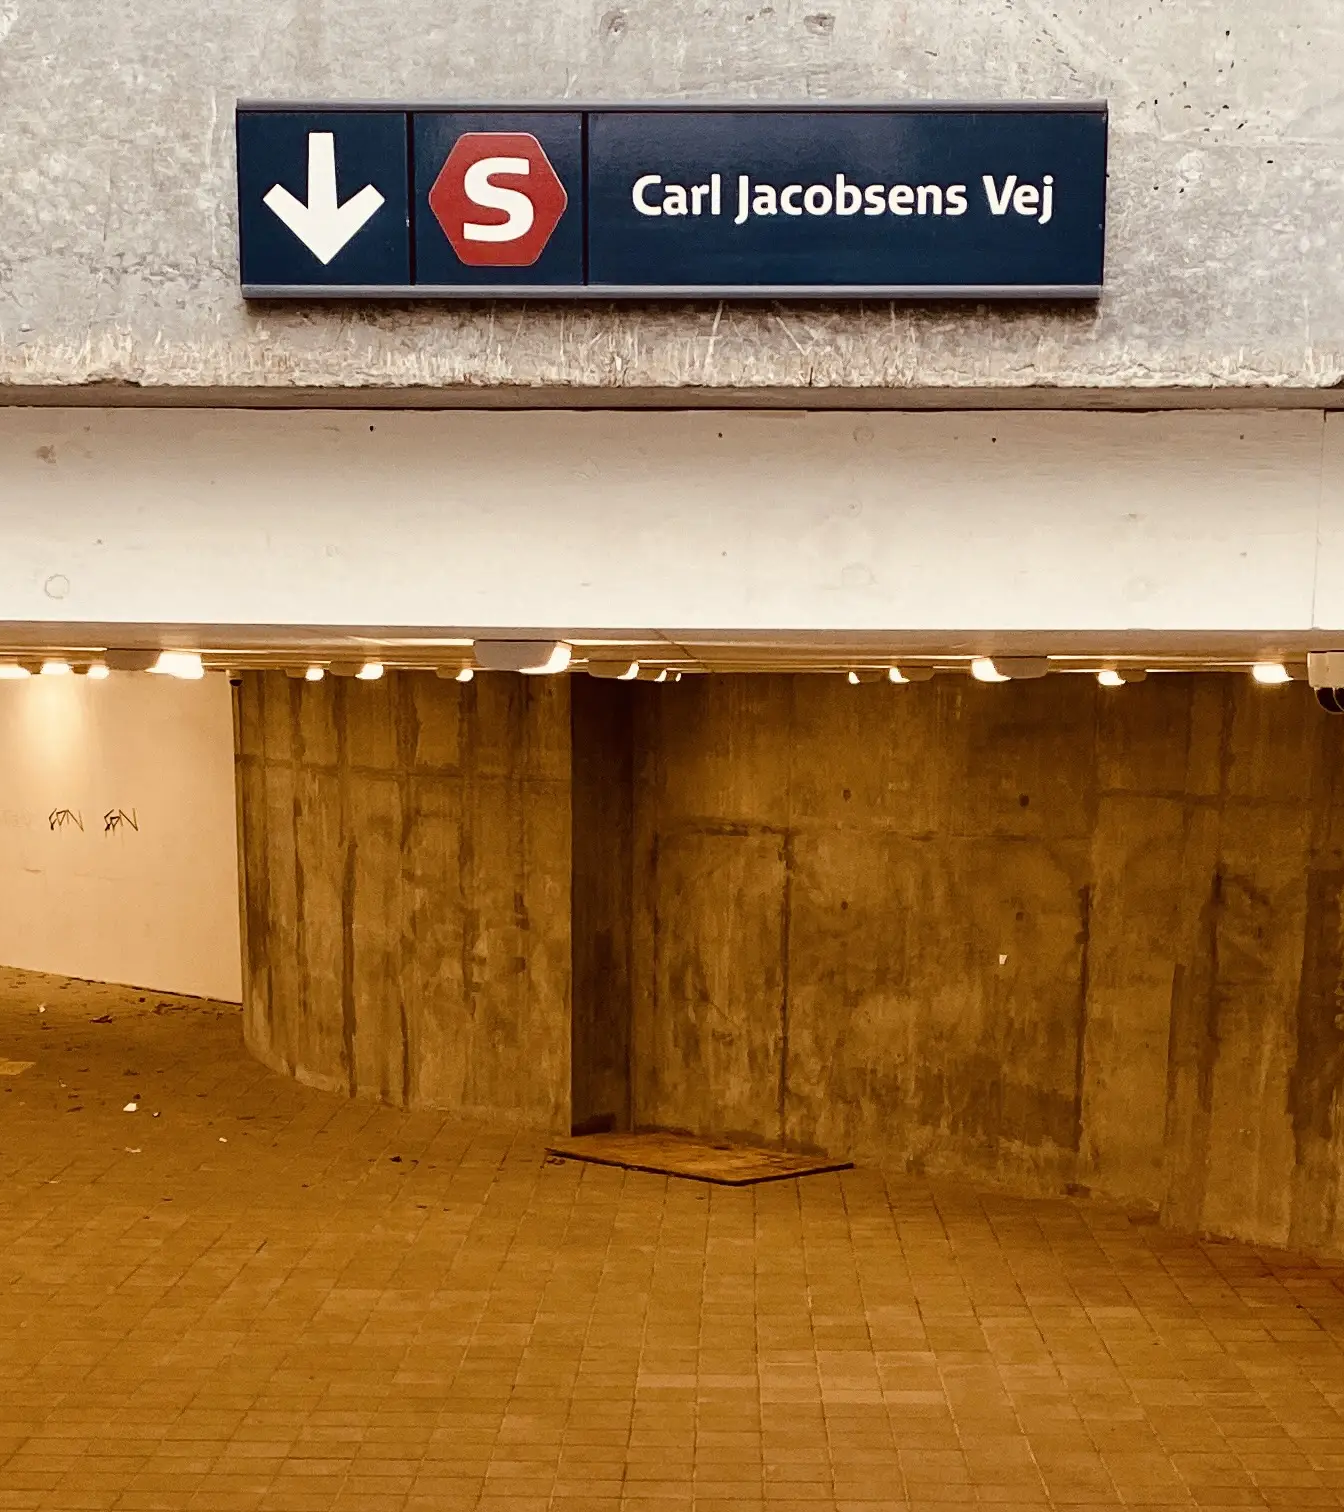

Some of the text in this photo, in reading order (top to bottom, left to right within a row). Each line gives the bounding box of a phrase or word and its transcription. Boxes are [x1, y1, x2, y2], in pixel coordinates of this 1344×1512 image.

[462, 156, 1055, 242] S Carl Jacobsens Vej
